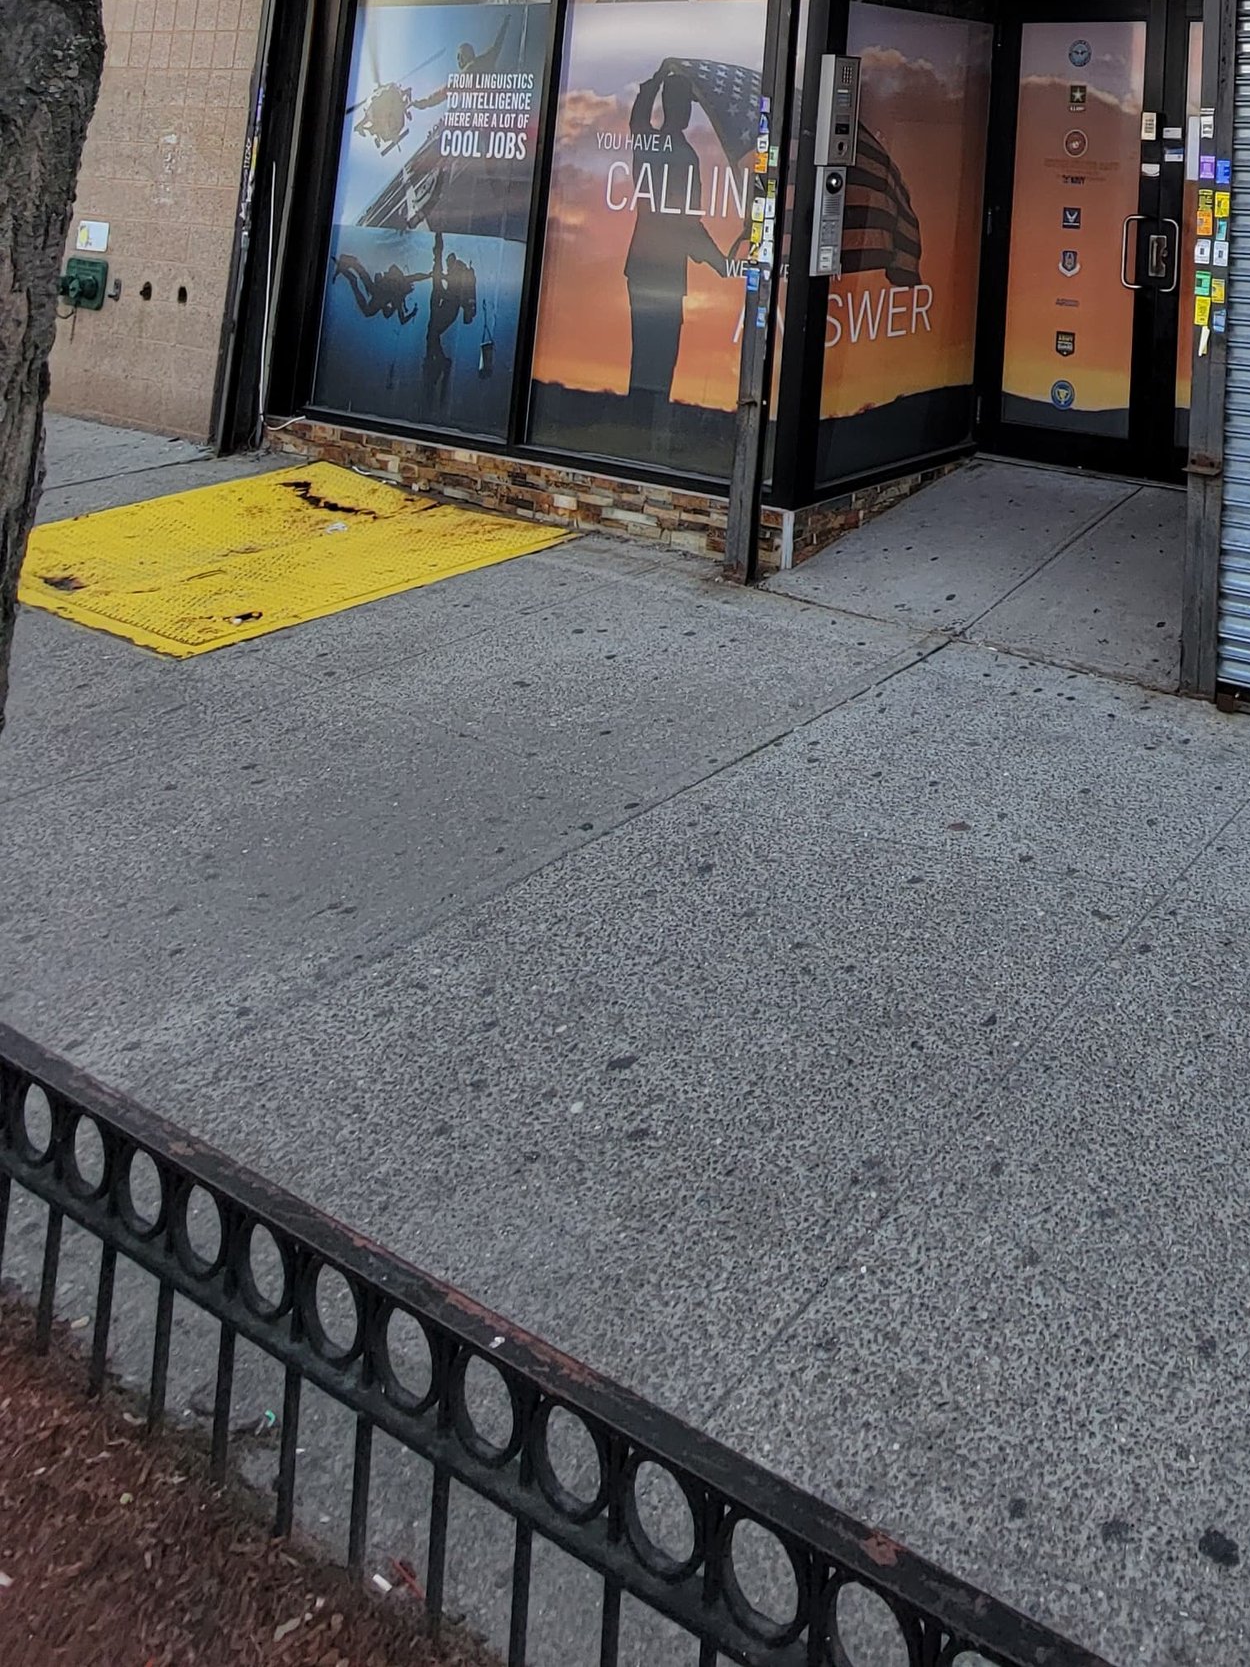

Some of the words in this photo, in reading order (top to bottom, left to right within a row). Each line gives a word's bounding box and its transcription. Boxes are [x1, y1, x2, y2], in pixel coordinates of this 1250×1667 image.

[447, 73, 473, 89] FROM
[475, 73, 534, 89] LINGUISTICS
[446, 92, 459, 109] TO
[461, 92, 532, 110] INTELLIGENCE
[444, 112, 471, 127] THERE
[472, 112, 490, 127] ARE
[491, 112, 497, 128] A
[499, 113, 516, 129] LOT
[517, 114, 530, 129] OF
[440, 130, 482, 158] COOL
[486, 131, 528, 161] JOBS
[596, 132, 621, 150] YOU
[624, 133, 661, 152] HAVE
[663, 135, 673, 152] A
[606, 161, 750, 219] CALLIN
[725, 259, 748, 279] WE
